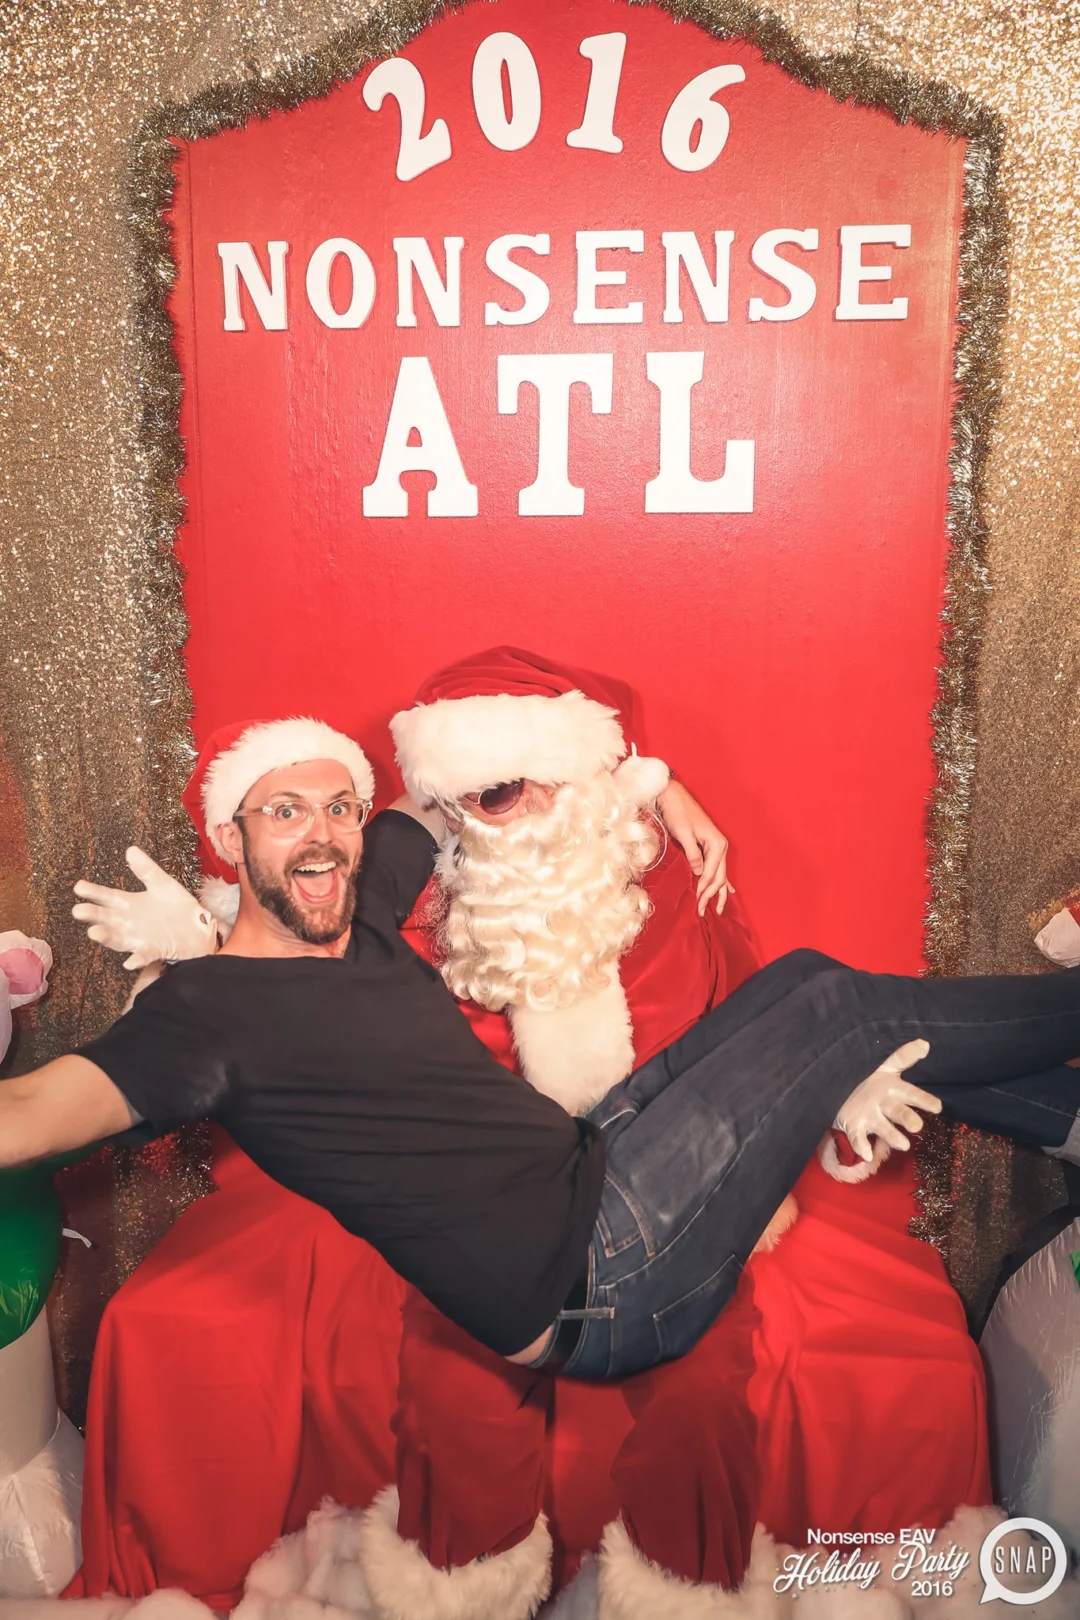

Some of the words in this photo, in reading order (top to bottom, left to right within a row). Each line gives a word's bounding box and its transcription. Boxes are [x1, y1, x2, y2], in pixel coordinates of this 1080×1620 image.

[363, 31, 746, 181] 2016
[217, 224, 912, 332] NONSENSE
[362, 351, 756, 518] ATL
